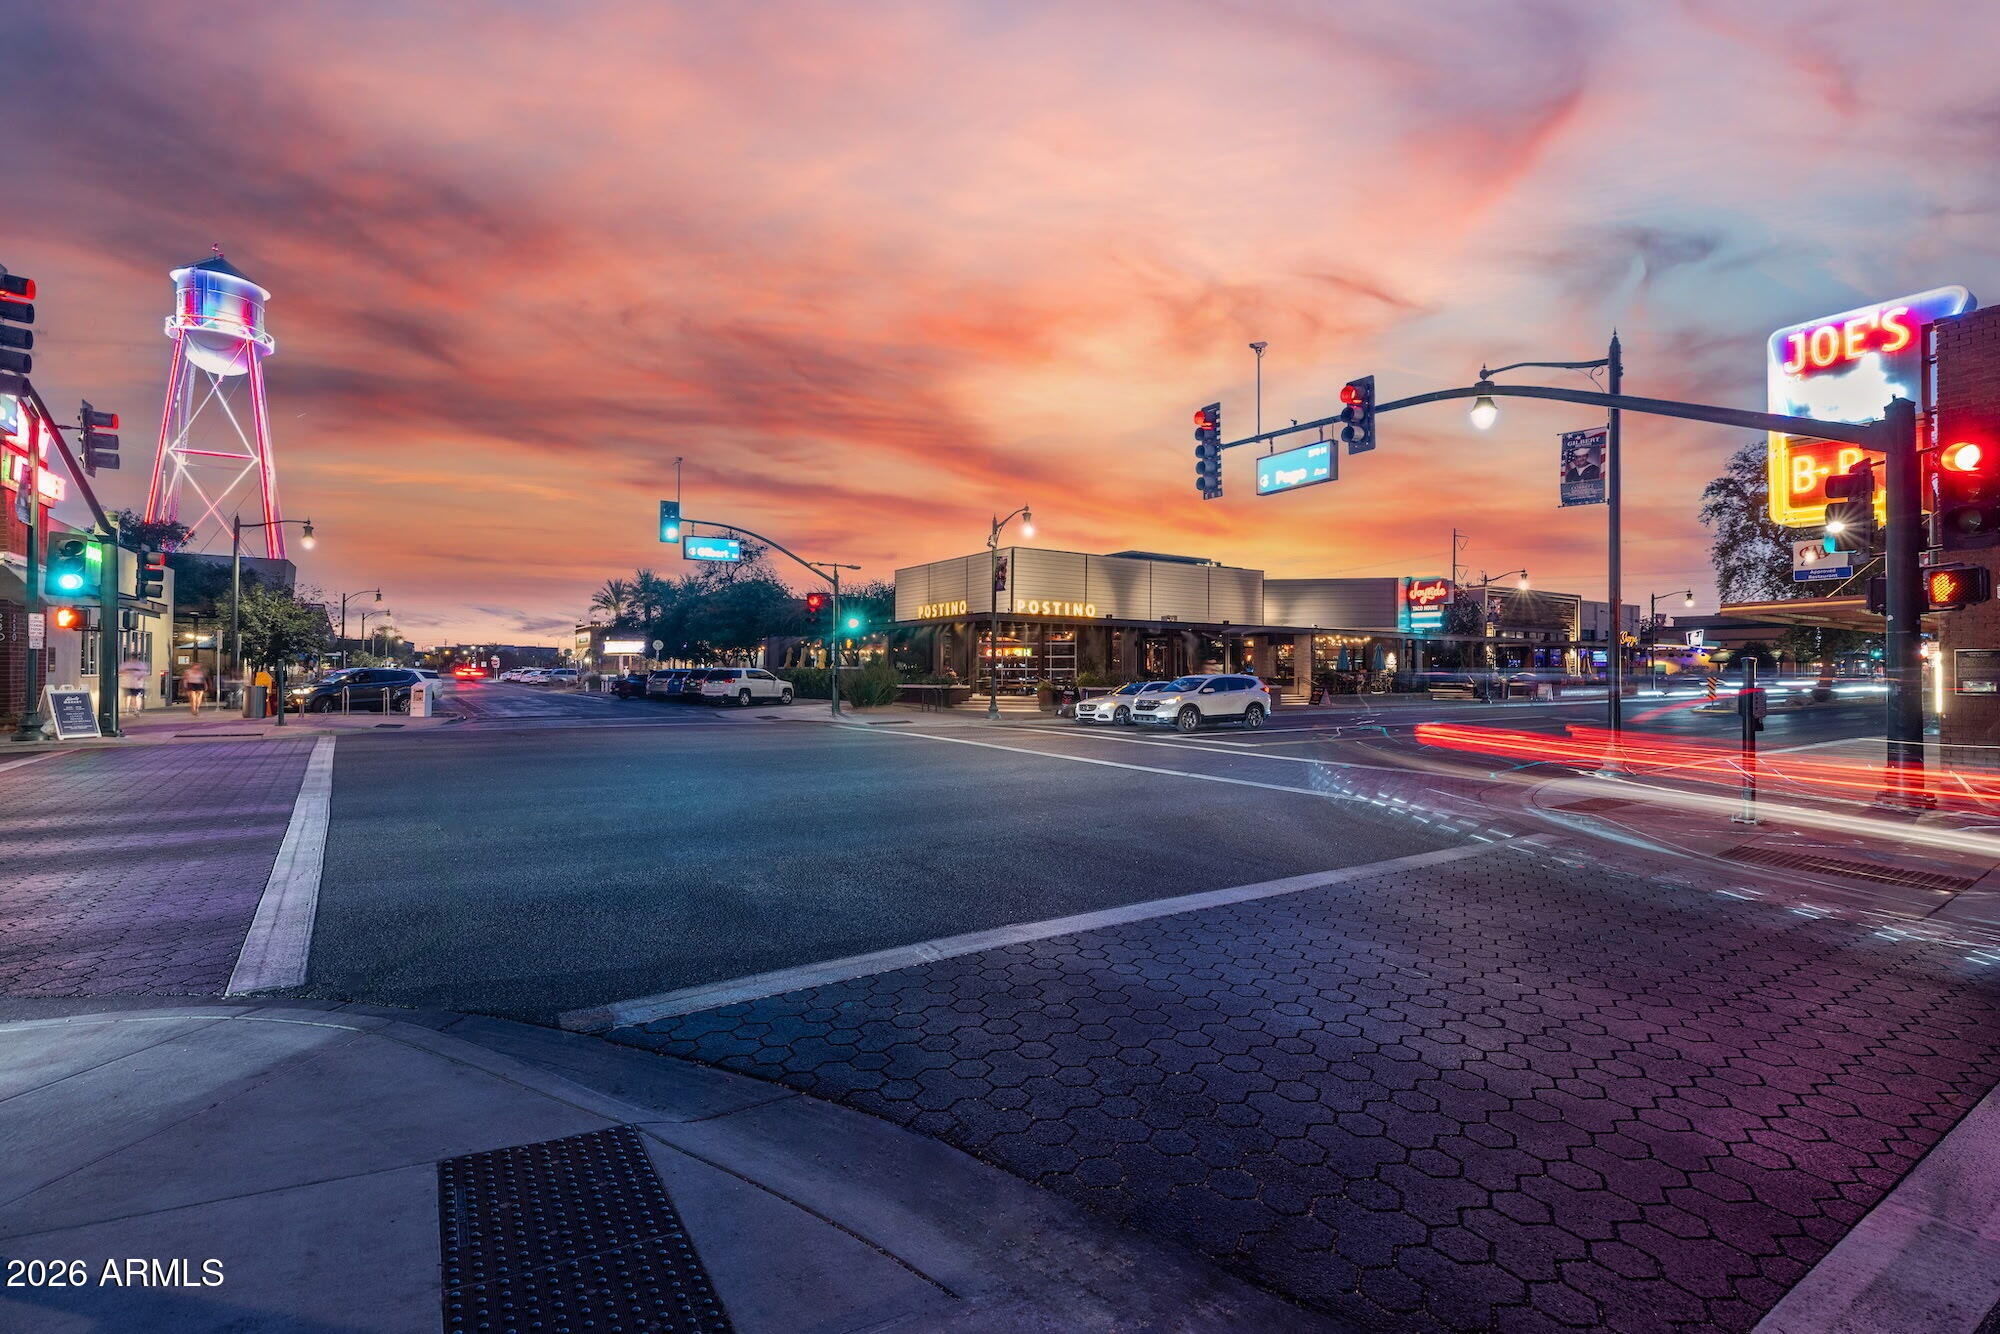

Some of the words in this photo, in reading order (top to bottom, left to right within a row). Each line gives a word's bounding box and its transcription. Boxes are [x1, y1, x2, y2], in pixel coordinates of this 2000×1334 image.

[1783, 306, 1910, 374] JOE'S
[1567, 437, 1600, 447] GILBERT
[917, 600, 967, 619] POSTINO
[1015, 600, 1097, 617] POSTINO
